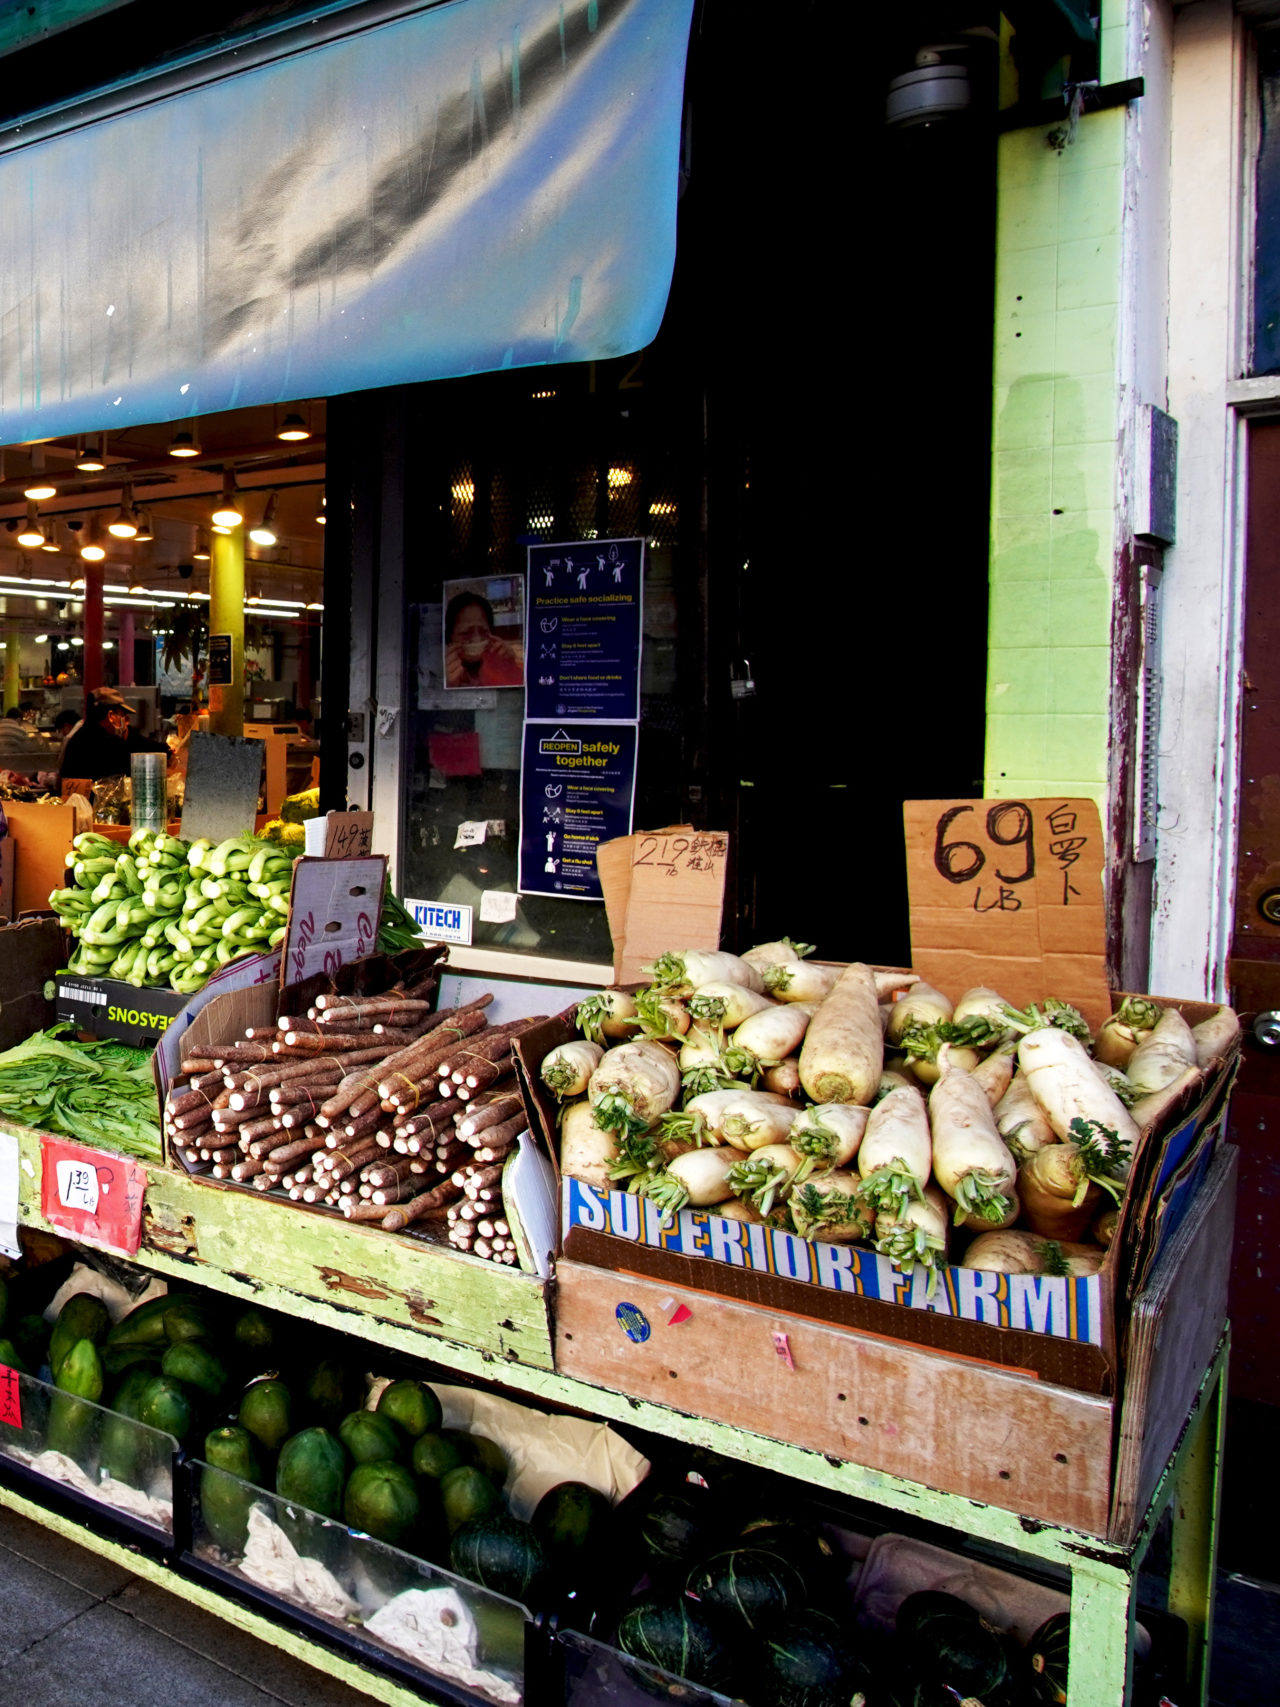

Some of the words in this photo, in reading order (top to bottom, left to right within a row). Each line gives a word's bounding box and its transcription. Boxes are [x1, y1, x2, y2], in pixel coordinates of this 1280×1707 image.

[535, 597, 569, 605] Practice
[569, 595, 587, 604] safe
[587, 593, 633, 605] socializing
[542, 742, 579, 751] REOPEN
[582, 741, 620, 755] safely
[556, 755, 609, 768] together
[934, 801, 1035, 884] 69
[973, 885, 1022, 912] LB
[414, 905, 461, 929] KITECH
[577, 1186, 856, 1294] SUPERIOR
